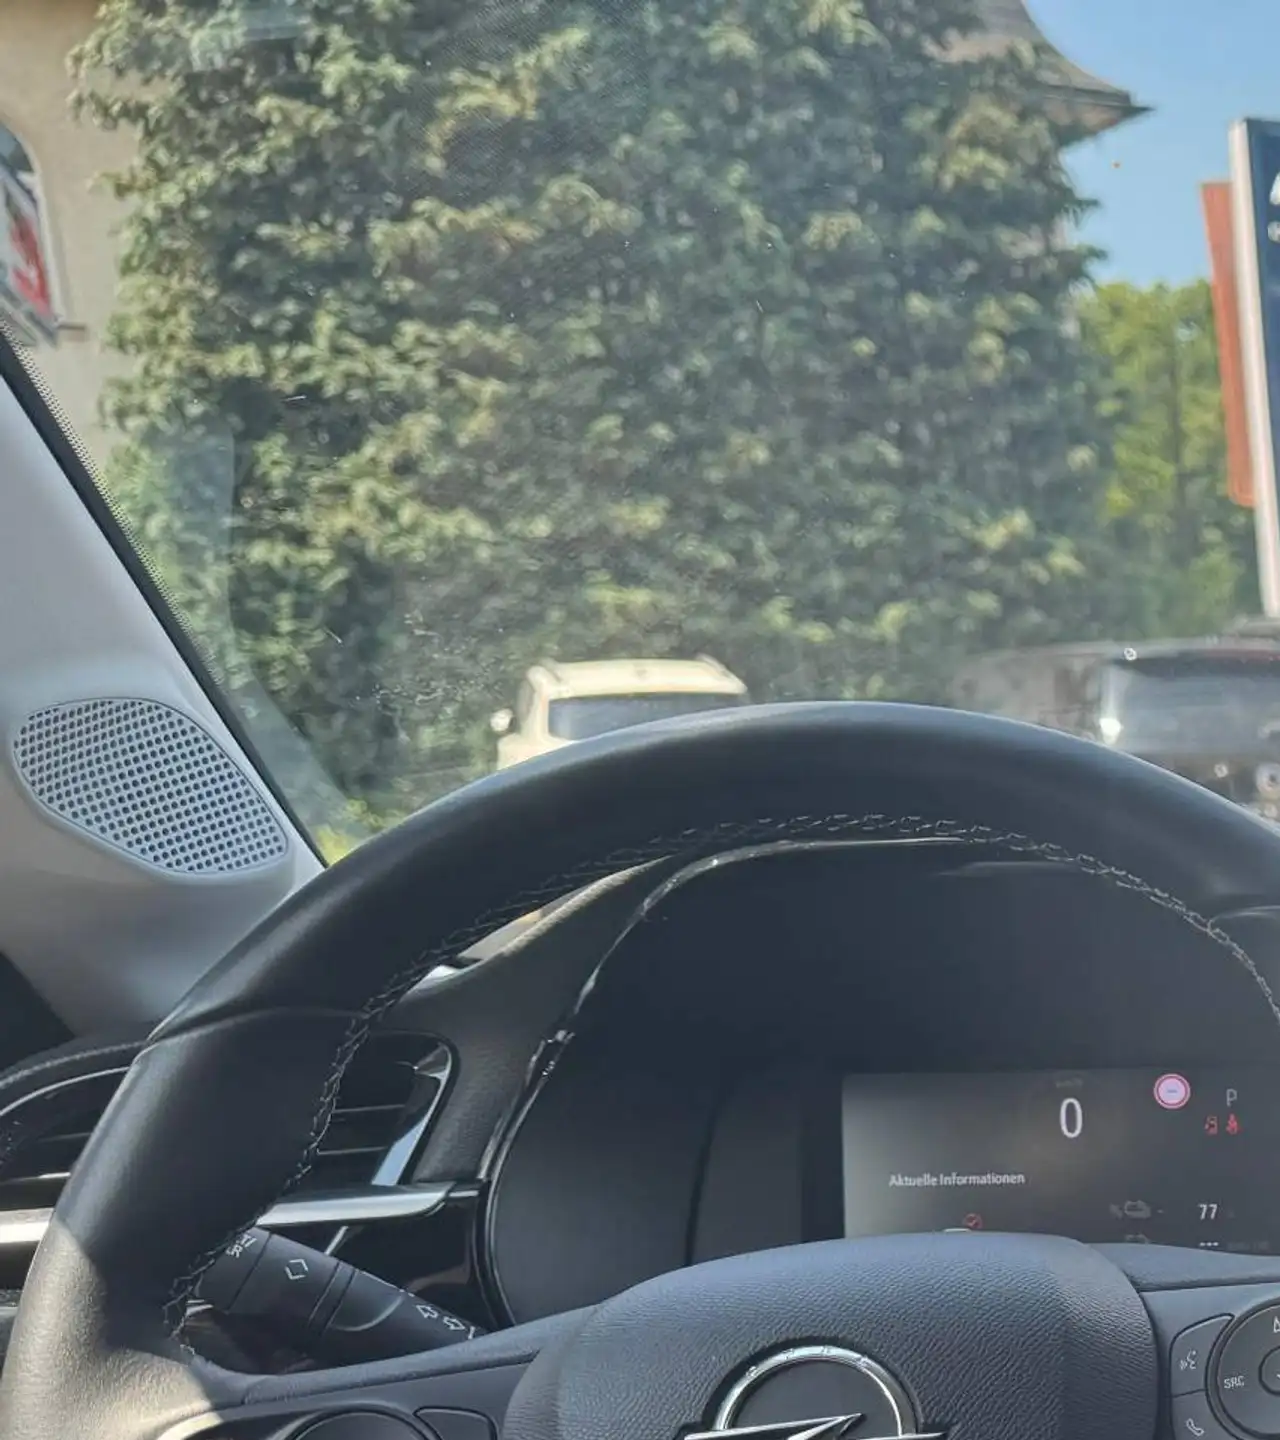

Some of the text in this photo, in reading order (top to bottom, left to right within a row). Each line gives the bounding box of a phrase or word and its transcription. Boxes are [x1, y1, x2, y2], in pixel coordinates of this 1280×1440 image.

[1226, 1088, 1238, 1107] P
[1059, 1098, 1083, 1138] 0
[889, 1171, 1026, 1187] Aktuelle Informationen
[1199, 1204, 1218, 1221] 77
[1224, 1375, 1245, 1389] SRC
